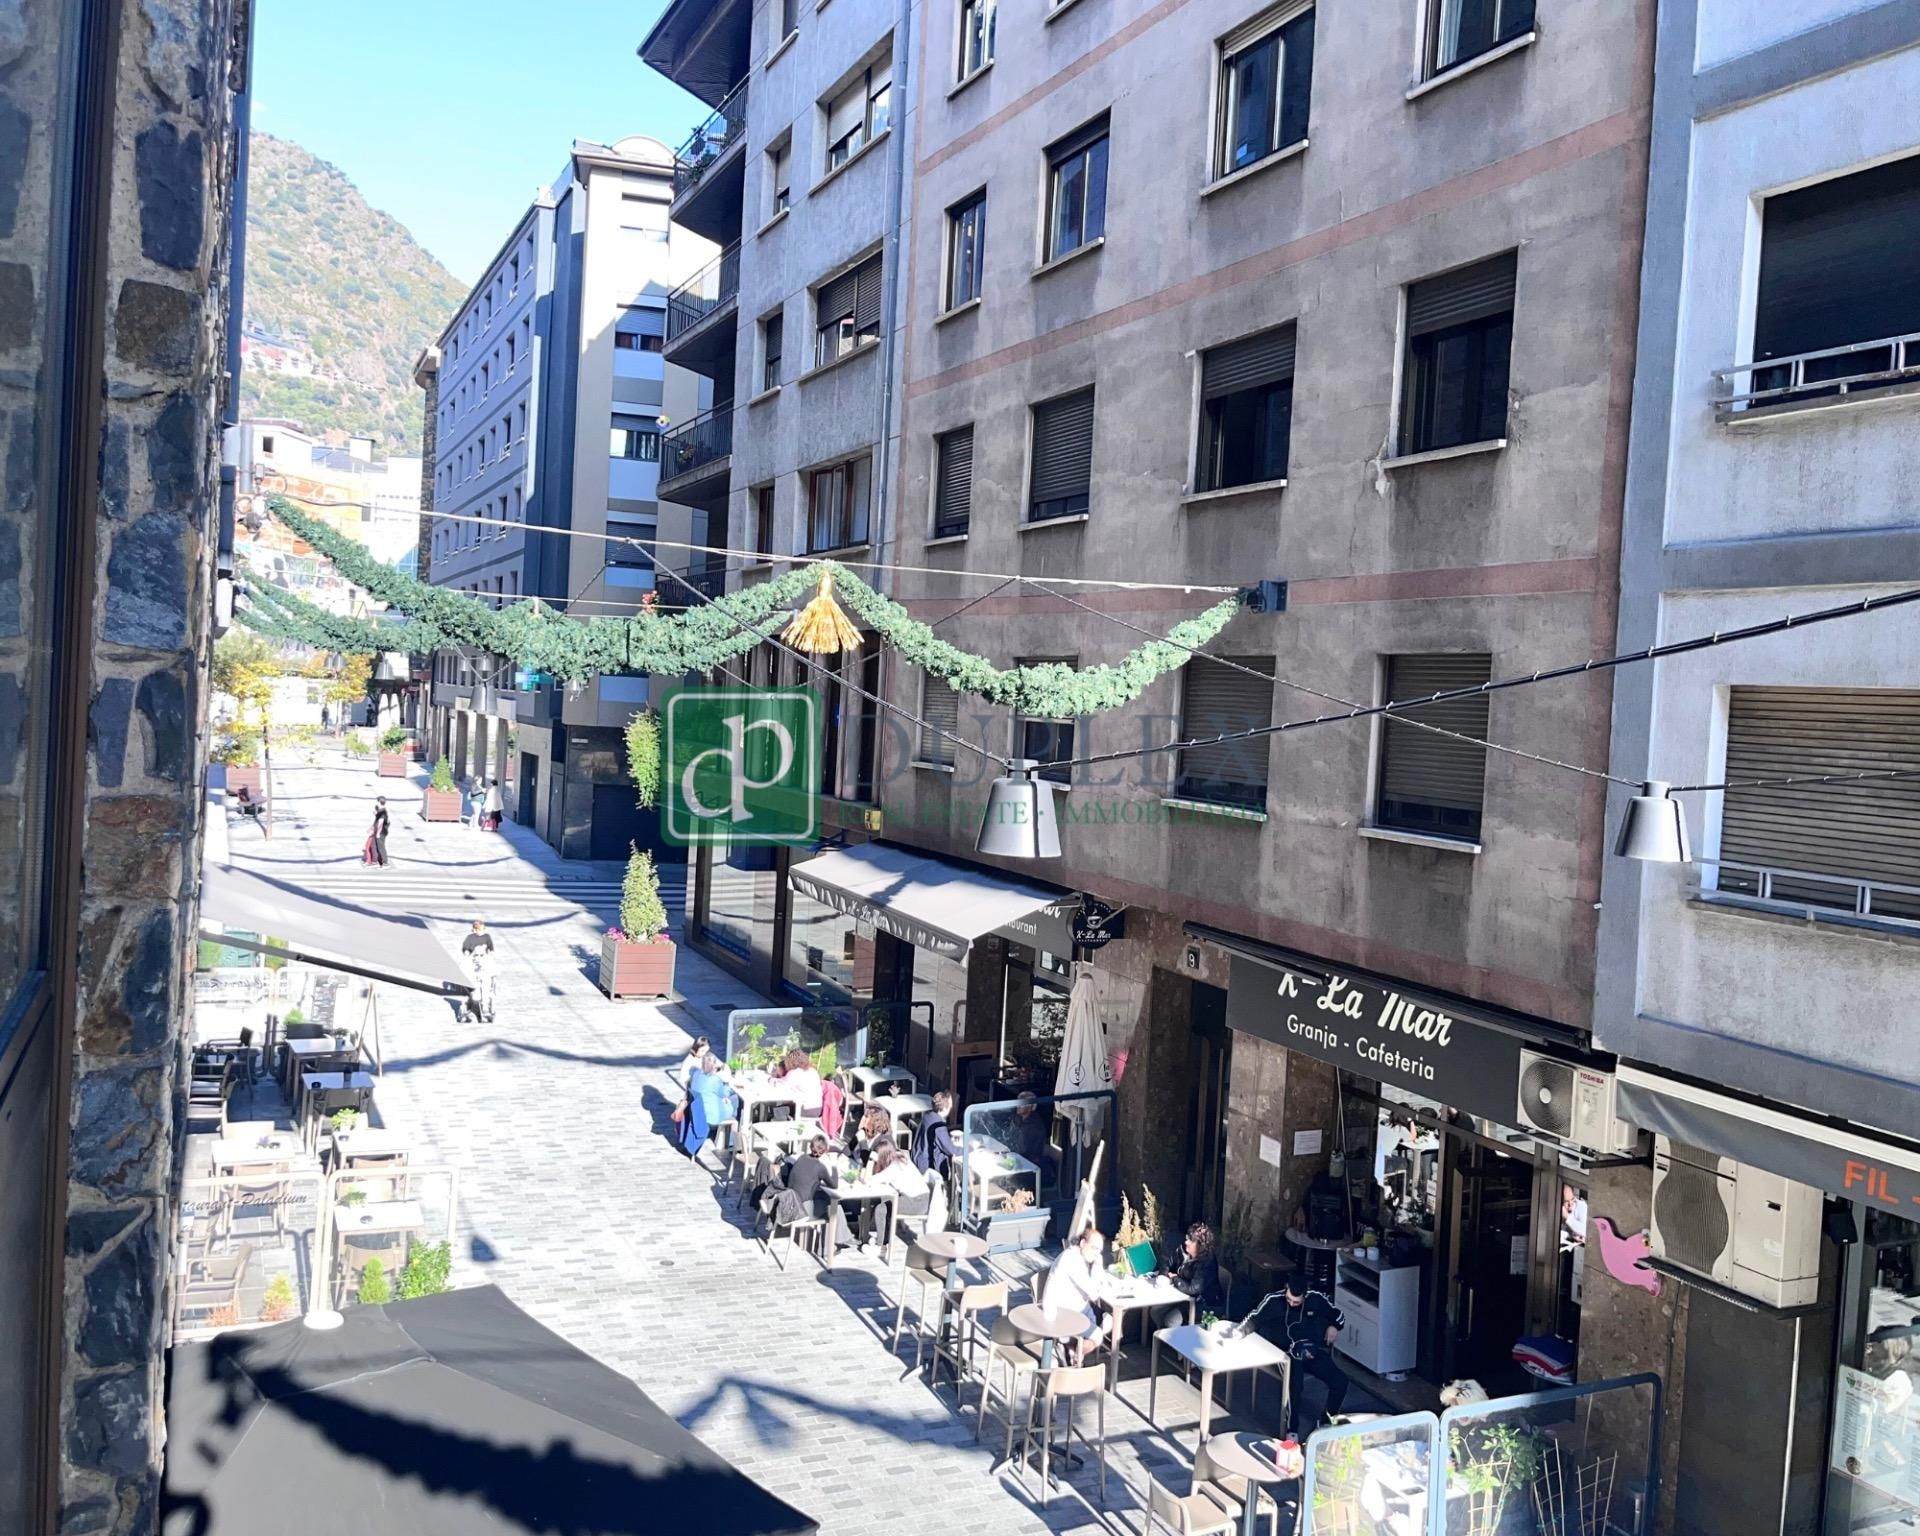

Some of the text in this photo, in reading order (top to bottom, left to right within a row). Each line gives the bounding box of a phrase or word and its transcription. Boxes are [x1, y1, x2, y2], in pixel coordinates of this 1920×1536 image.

[1188, 953, 1195, 968] 9
[1377, 990, 1452, 1046] Mar
[1287, 1014, 1337, 1049] Granja
[1356, 1037, 1434, 1080] Cafeteria
[1843, 1160, 1900, 1204] FIL
